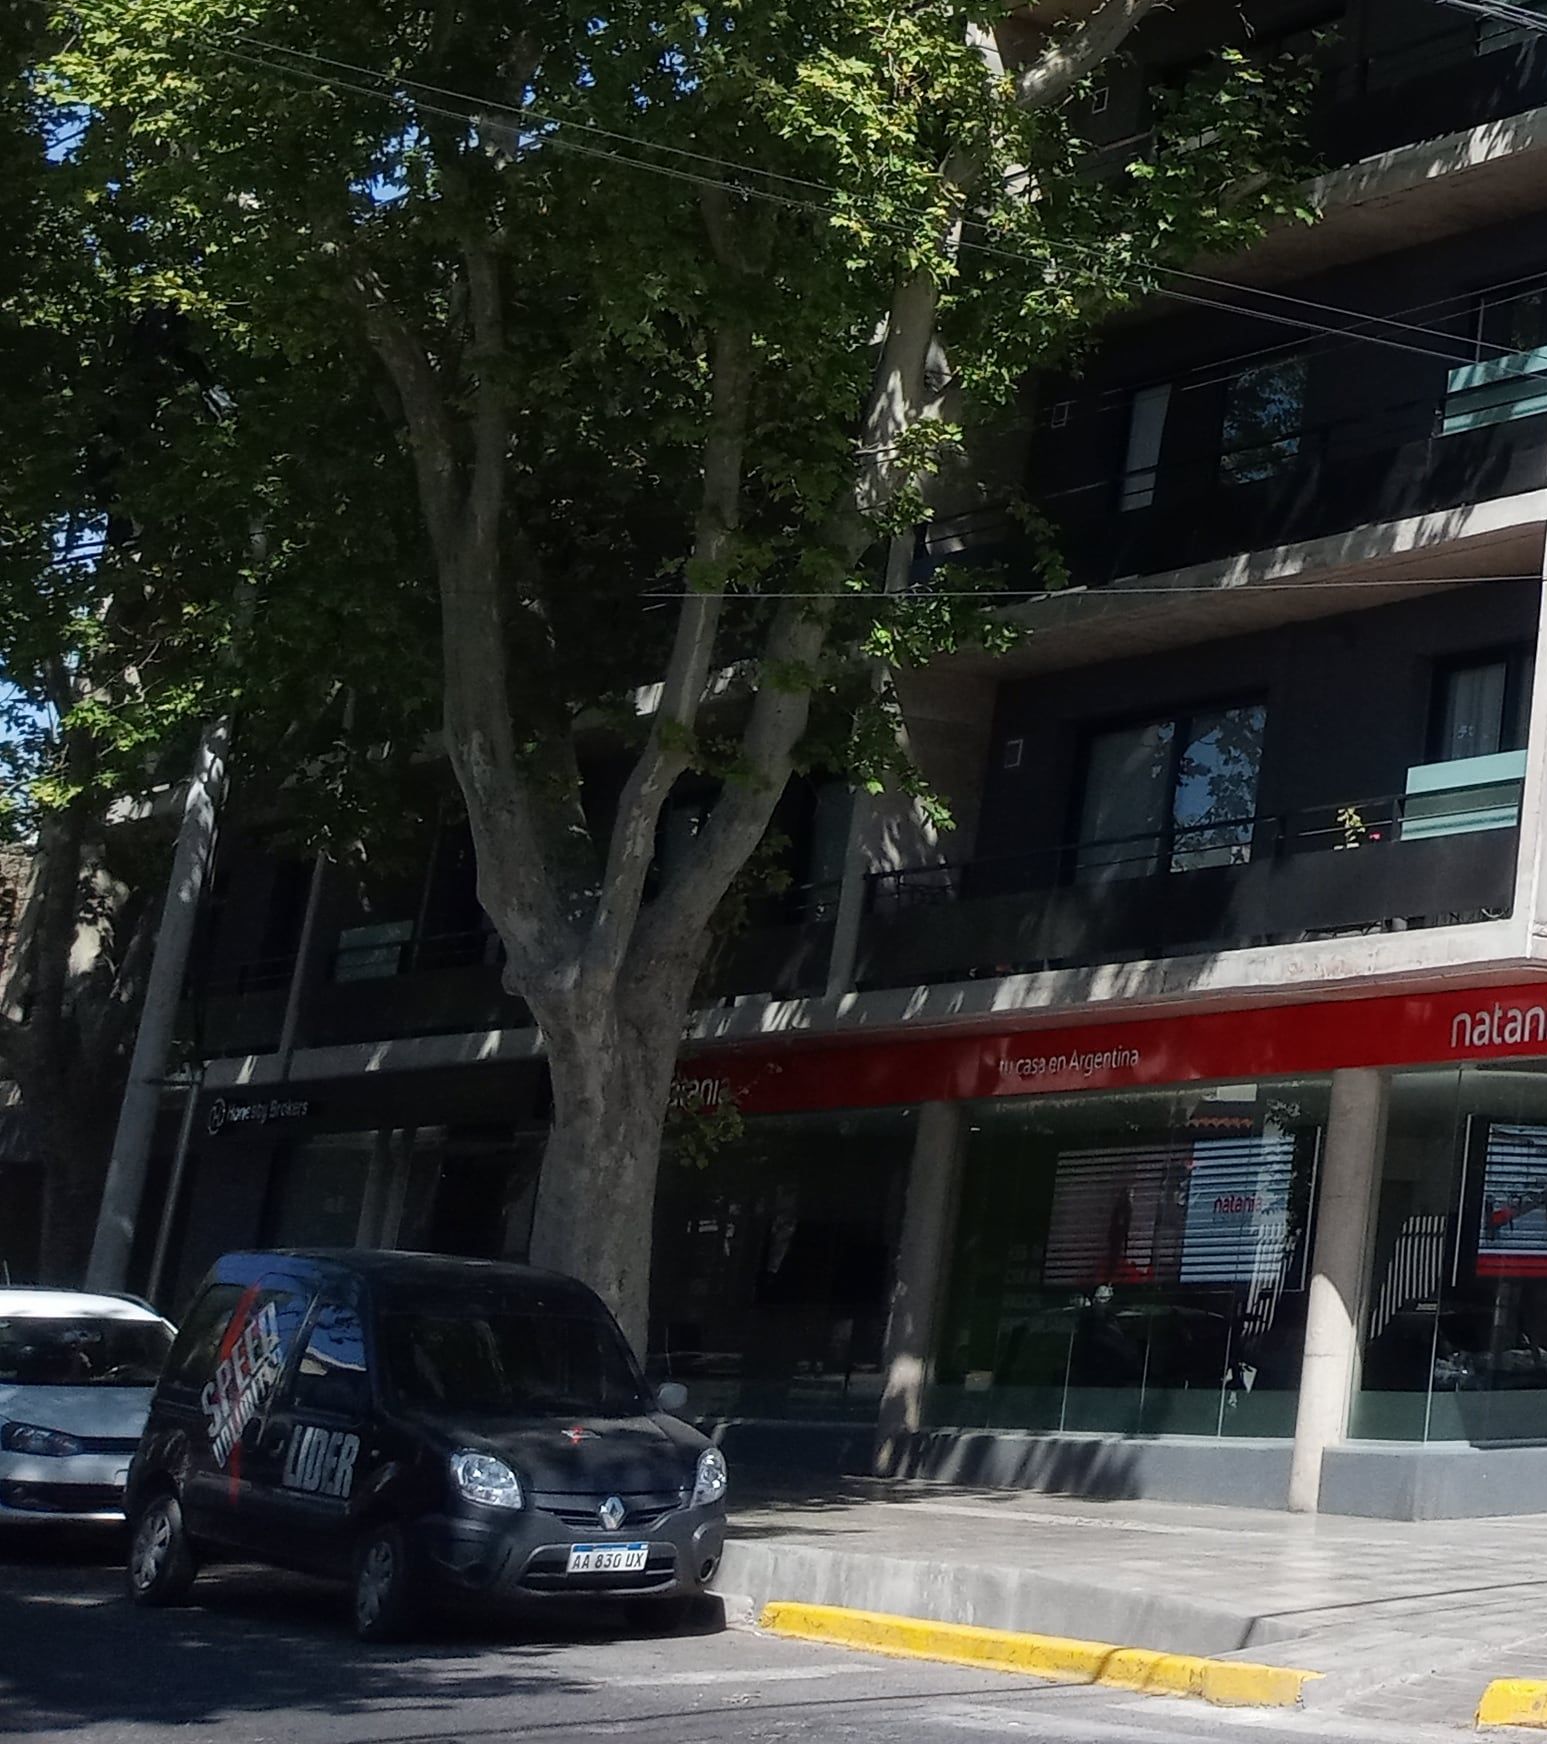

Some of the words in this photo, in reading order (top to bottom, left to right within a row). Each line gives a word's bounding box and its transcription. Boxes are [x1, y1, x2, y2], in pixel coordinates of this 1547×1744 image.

[1015, 1058, 1046, 1076] casa
[1048, 1056, 1066, 1073] en
[1068, 1045, 1139, 1077] Argentina
[282, 1424, 361, 1498] LIDER
[572, 1554, 590, 1569] AA
[594, 1553, 622, 1569] 830
[625, 1552, 645, 1568] UX
